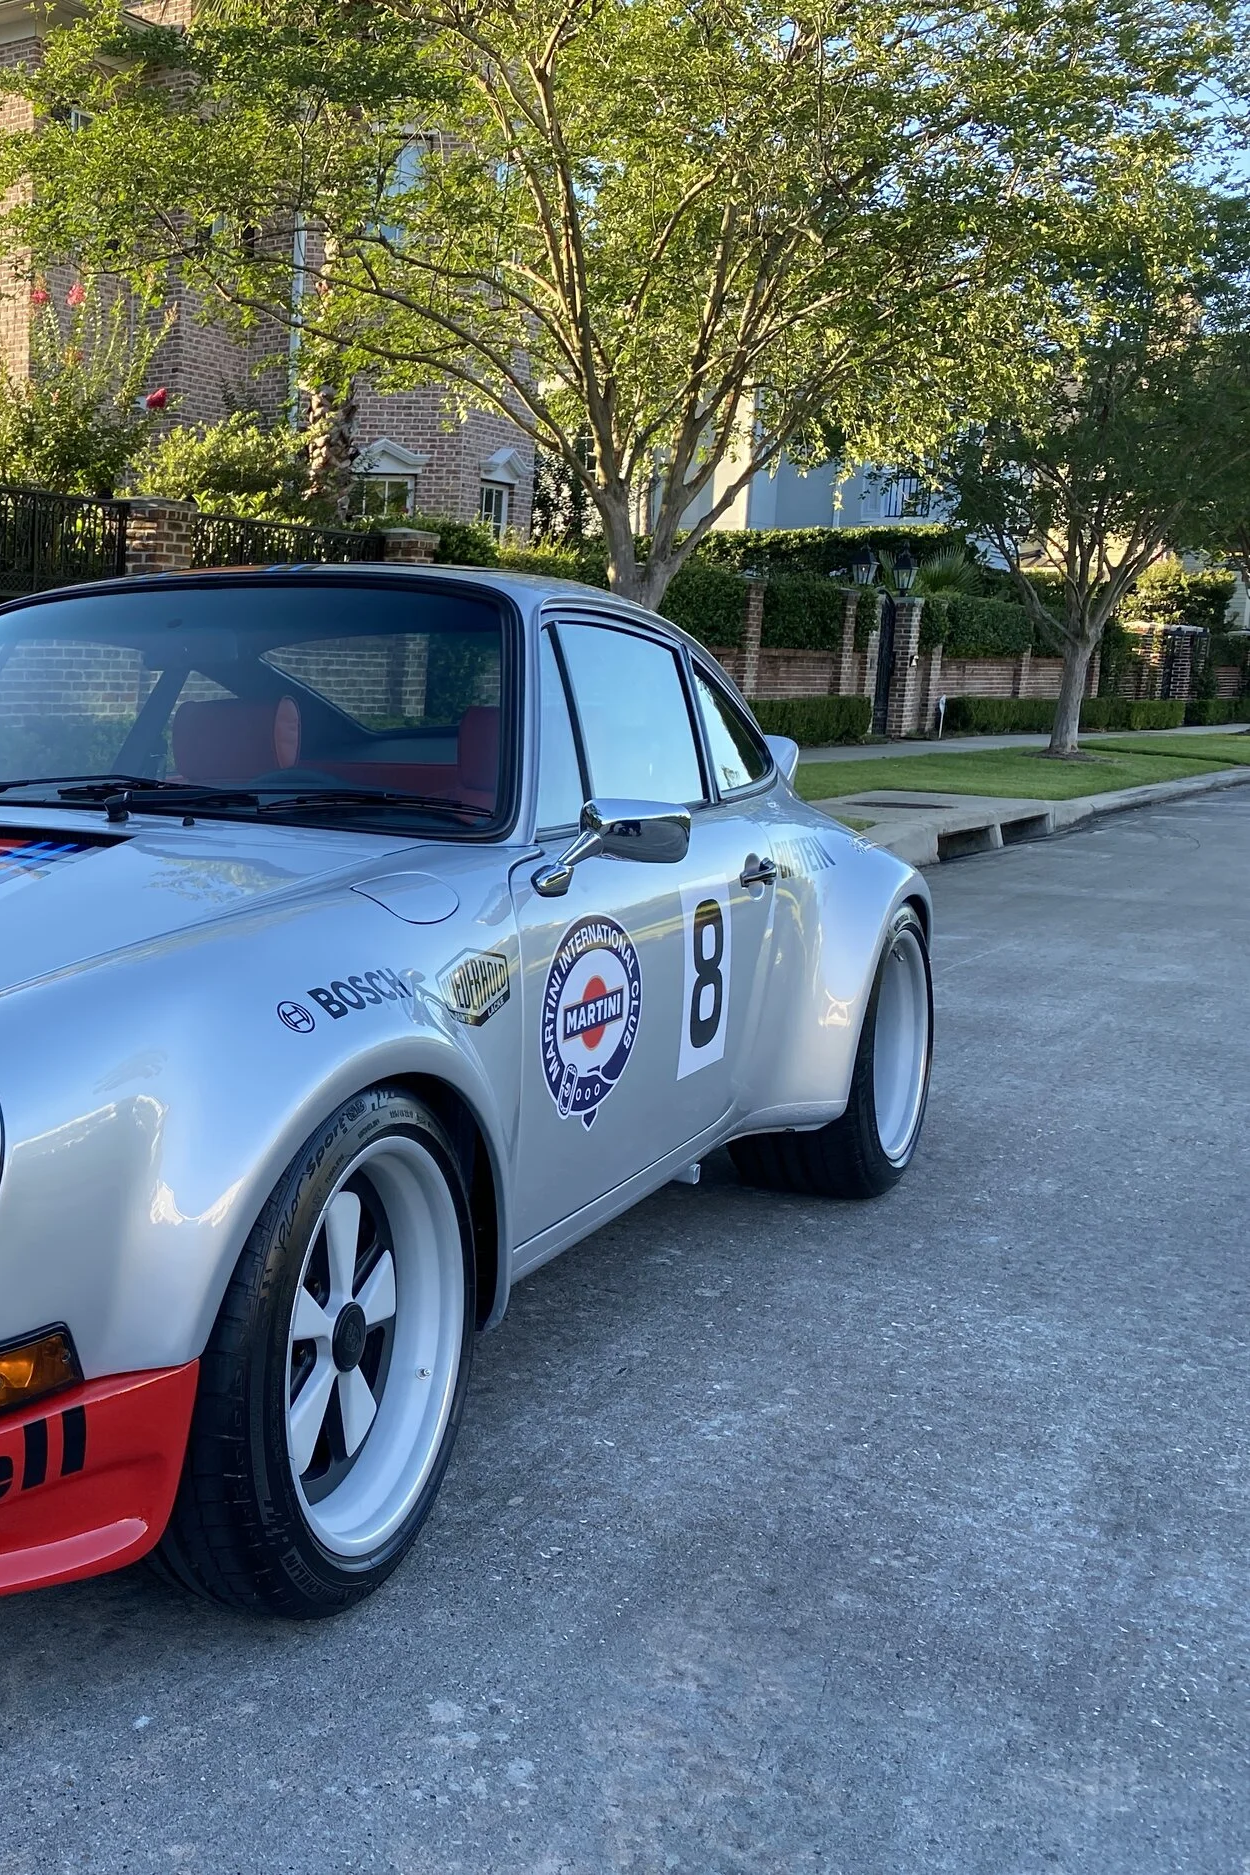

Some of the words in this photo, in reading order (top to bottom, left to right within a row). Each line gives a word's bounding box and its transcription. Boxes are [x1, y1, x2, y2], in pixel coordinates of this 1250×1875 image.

[306, 967, 414, 1020] BOSCH
[544, 969, 562, 1083] MARTINI
[559, 923, 635, 978] INTERNATIONAL
[623, 980, 640, 1051] CLUB
[566, 993, 622, 1034] MARTINI
[688, 897, 725, 1050] 8
